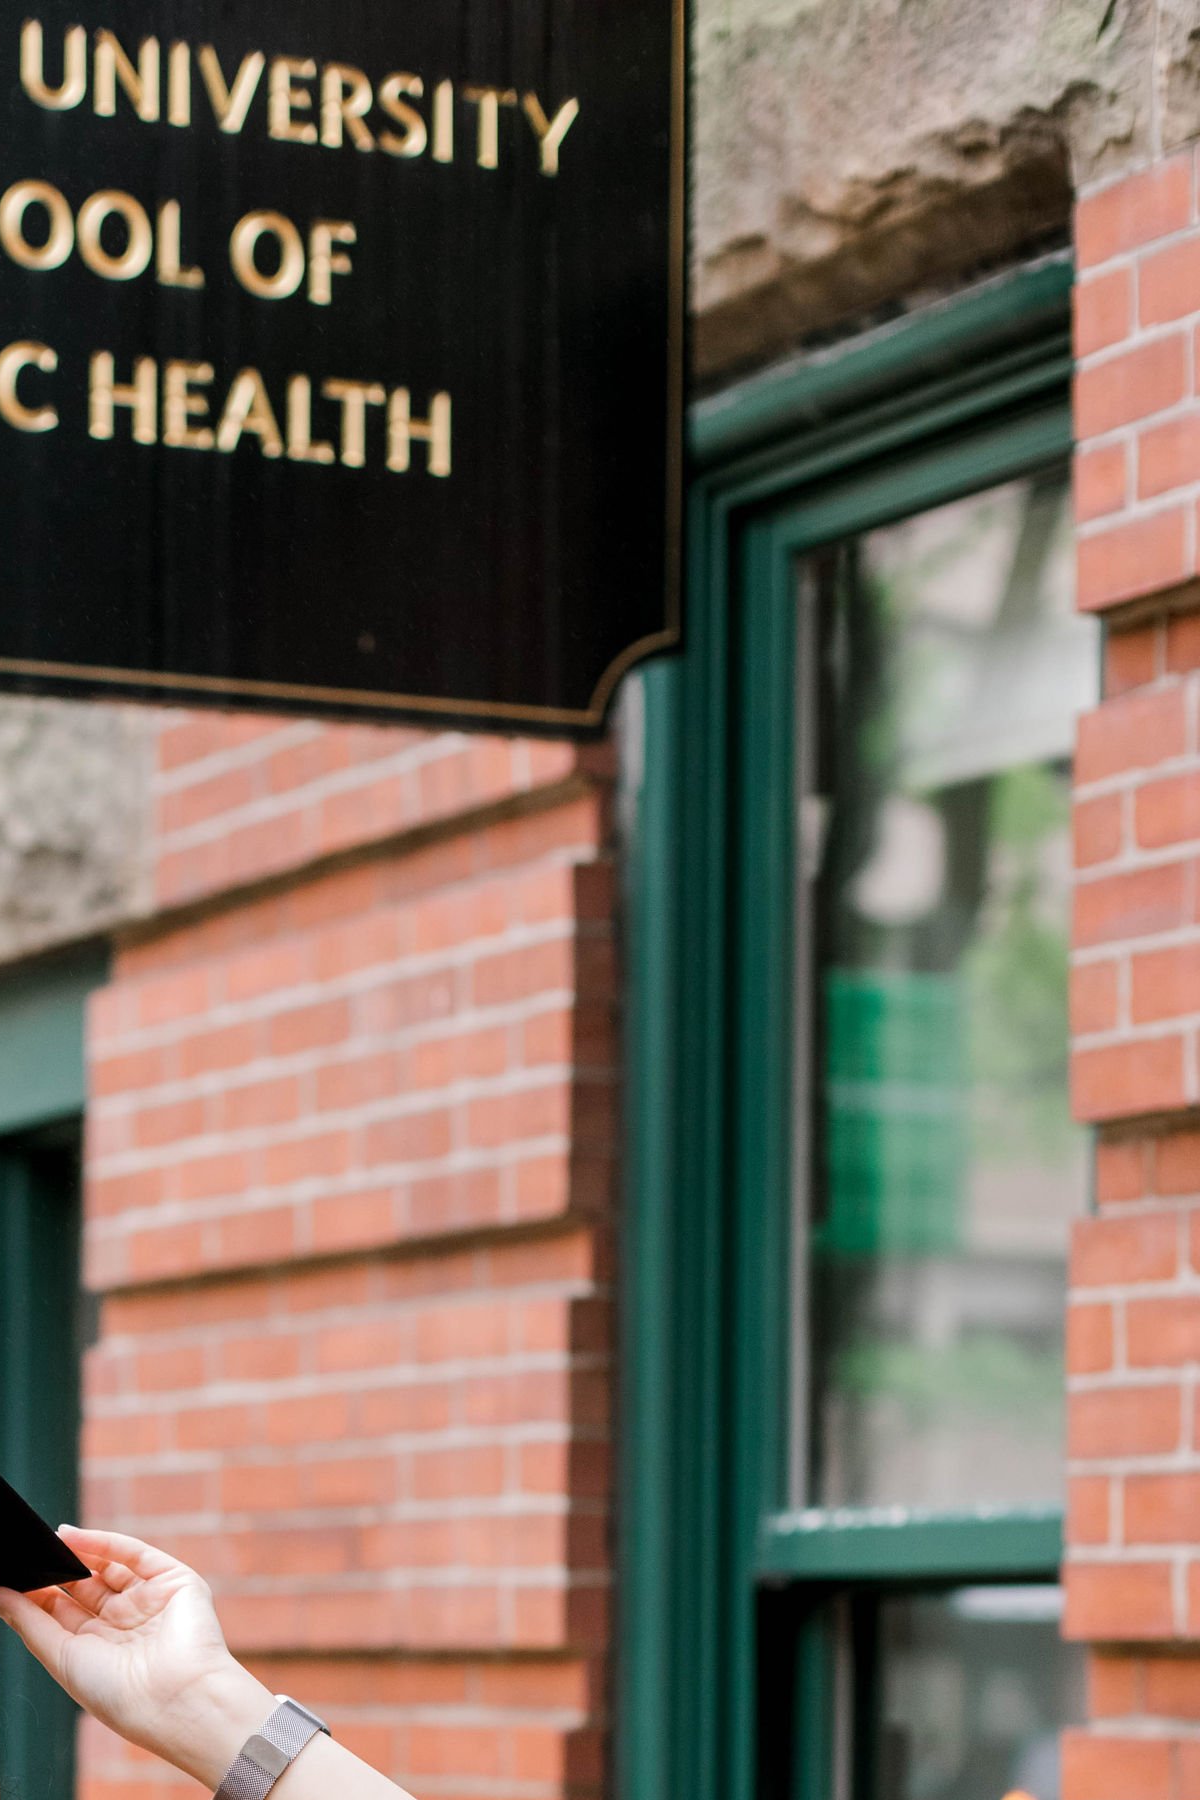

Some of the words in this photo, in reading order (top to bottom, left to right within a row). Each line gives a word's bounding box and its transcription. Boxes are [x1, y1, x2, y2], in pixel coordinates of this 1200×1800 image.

[19, 19, 580, 175] UNIVERSITY
[230, 211, 357, 306] OF
[88, 350, 453, 478] HEALTH
